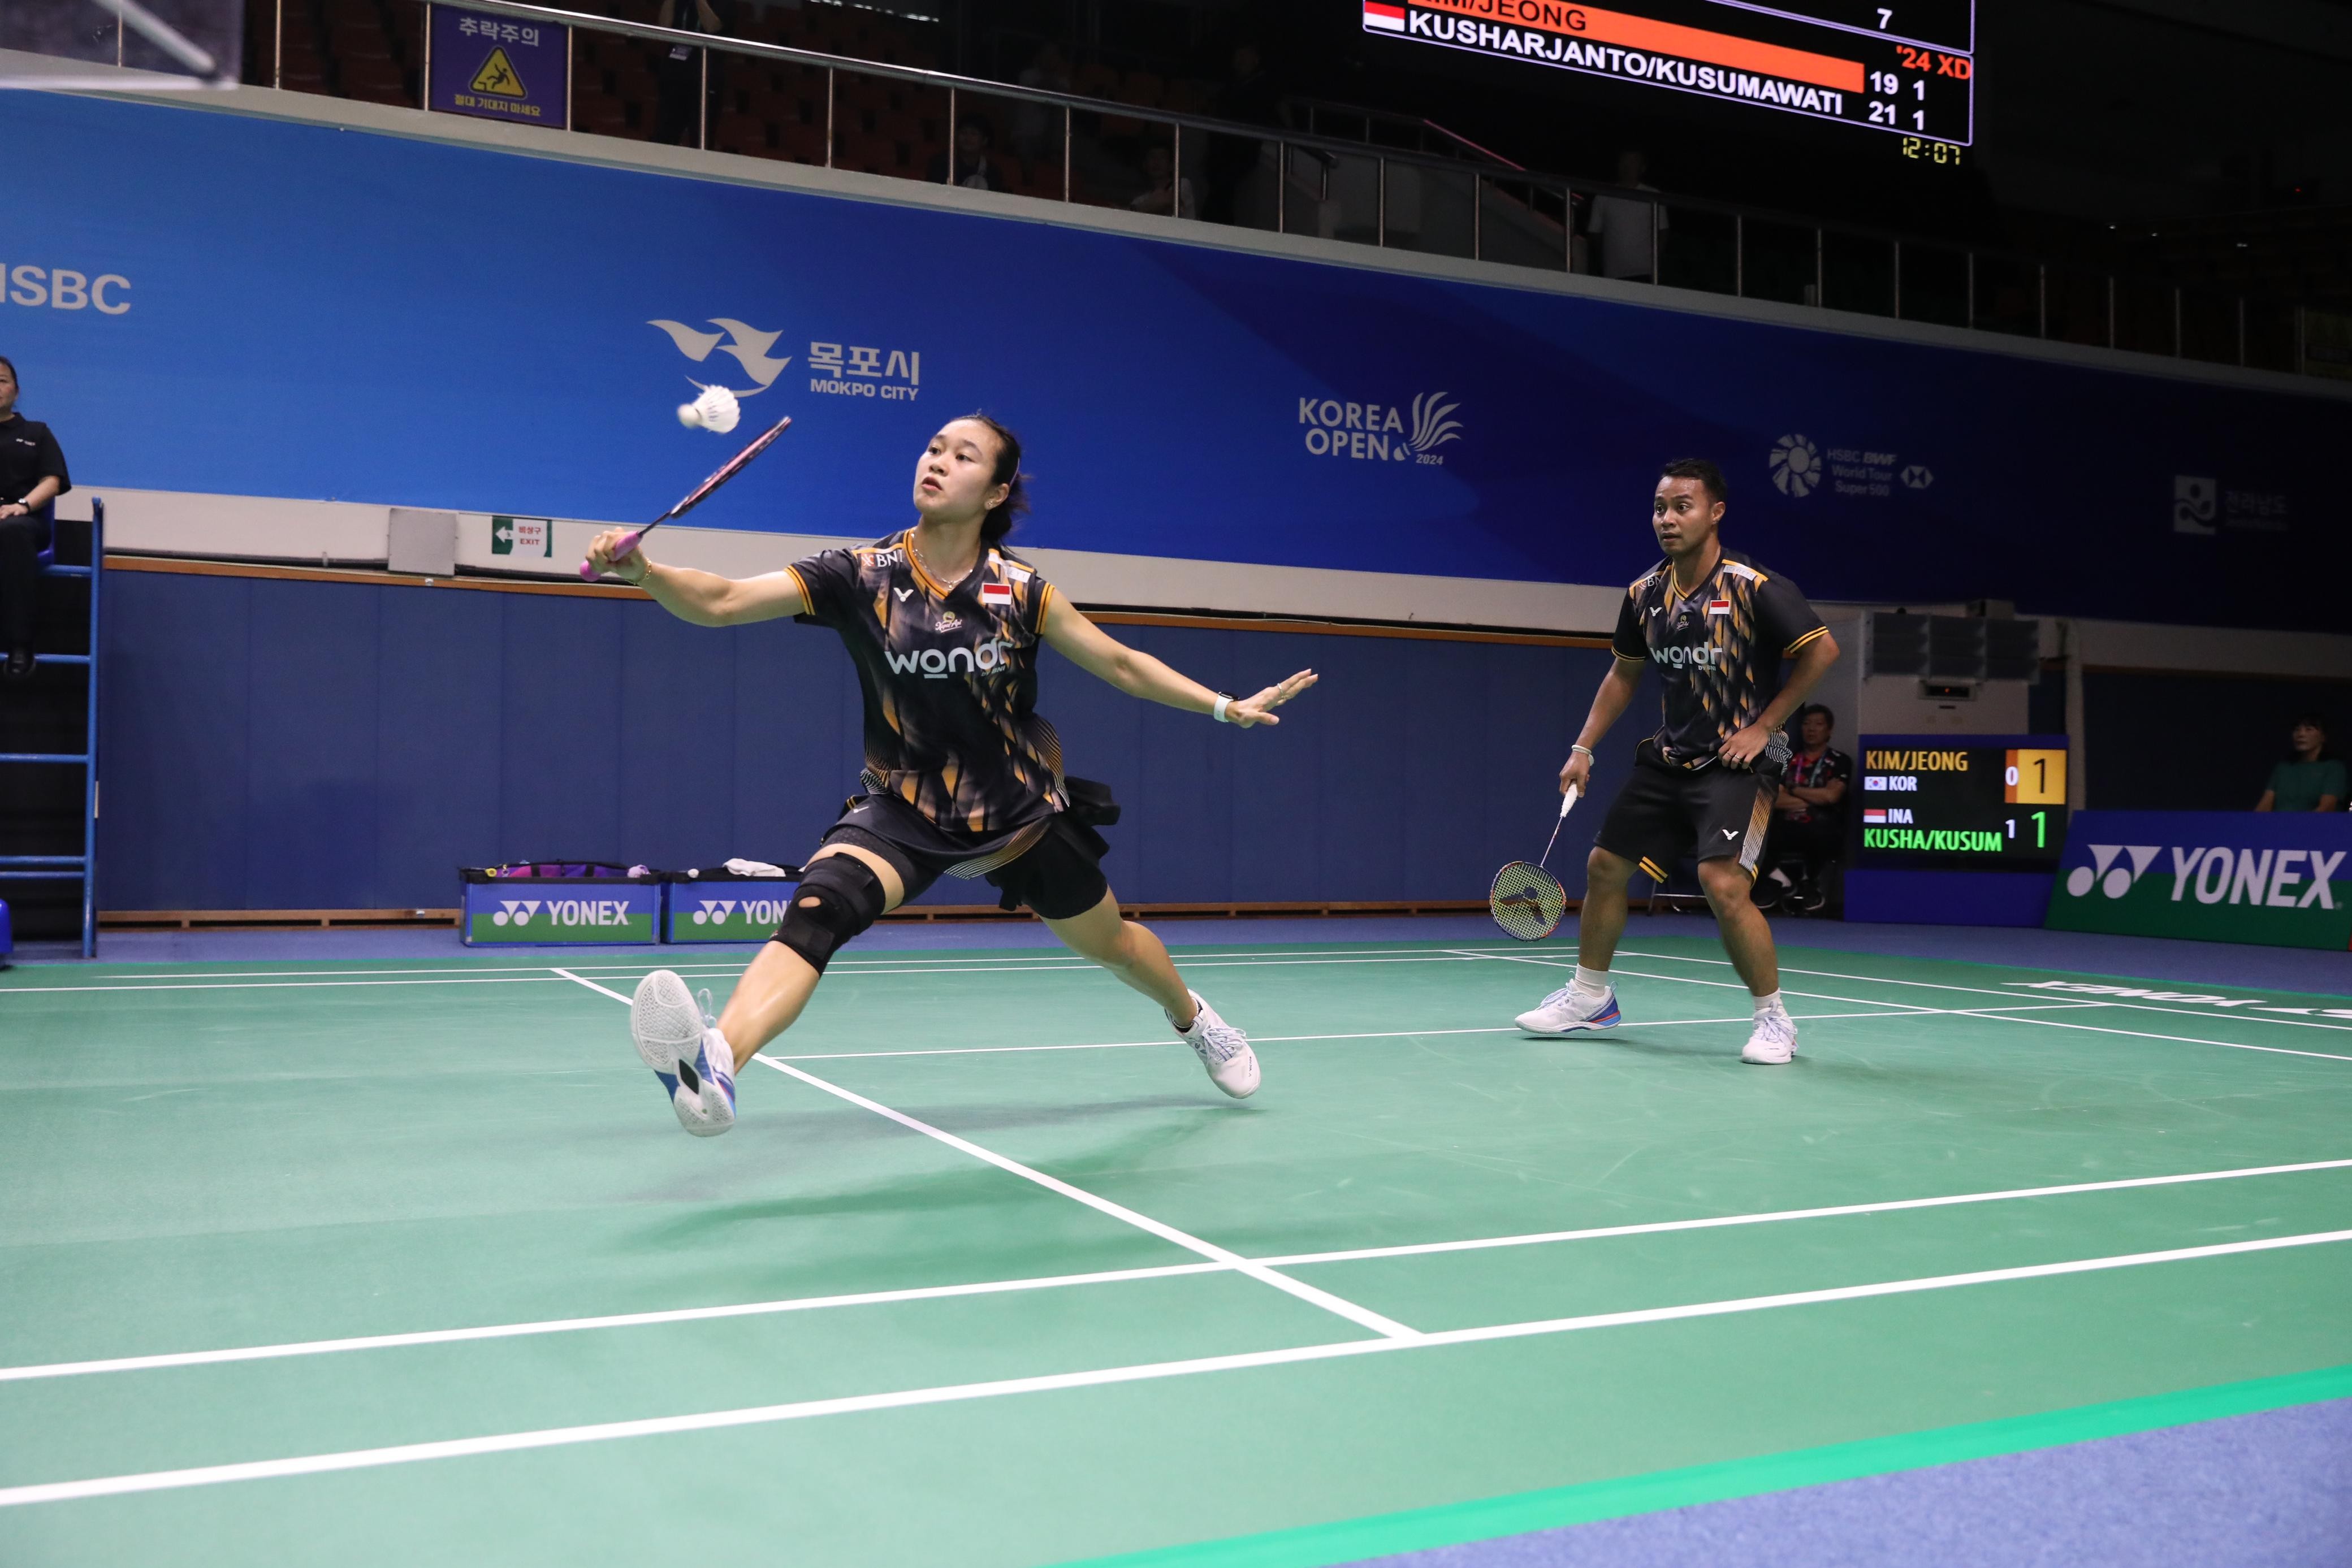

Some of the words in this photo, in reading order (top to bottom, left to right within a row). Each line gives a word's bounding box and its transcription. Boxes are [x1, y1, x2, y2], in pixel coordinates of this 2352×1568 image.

[1426, 0, 1586, 31] JEONG
[1877, 8, 1892, 29] 7
[459, 17, 539, 47] 추락주의
[1410, 10, 1843, 115] KUSHARJANTO/KUSUMAWATI
[1896, 46, 1931, 71] '24
[1937, 55, 1971, 80] XD
[1870, 71, 1899, 94] 19
[1913, 80, 1925, 101] 1
[478, 97, 508, 111] 기대지
[510, 102, 541, 116] 마세요
[1869, 101, 1896, 125] 21
[1912, 110, 1924, 130] 1
[1903, 137, 1960, 165] 12:07
[807, 342, 920, 386] 목포시
[810, 378, 876, 398] MOKPO
[880, 385, 919, 401] CITY
[1299, 397, 1404, 433] KOREA
[1305, 428, 1389, 461] OPEN
[1416, 454, 1443, 465] 2024
[1827, 449, 1861, 463] HSBC
[1862, 452, 1897, 466] BWF
[1832, 464, 1867, 480] World
[1867, 467, 1893, 481] Tour
[1835, 480, 1867, 496] Super
[1869, 483, 1890, 497] 500
[876, 549, 904, 568] BNI
[1647, 575, 1663, 587] BN
[885, 637, 1014, 679] wondr
[1649, 642, 1723, 669] wondr
[1866, 751, 1968, 772] KIM/JEONG
[1888, 776, 1917, 792] KOR
[2005, 766, 2019, 786] 0
[2033, 759, 2046, 794] 1
[1888, 809, 1913, 824] INA
[2005, 819, 2016, 839] 1
[1864, 828, 2003, 852] KUSHA/KUSUM
[2031, 812, 2046, 848] 1
[2171, 846, 2347, 909] YONEX
[547, 900, 630, 926] YONEX
[741, 900, 792, 925] YON
